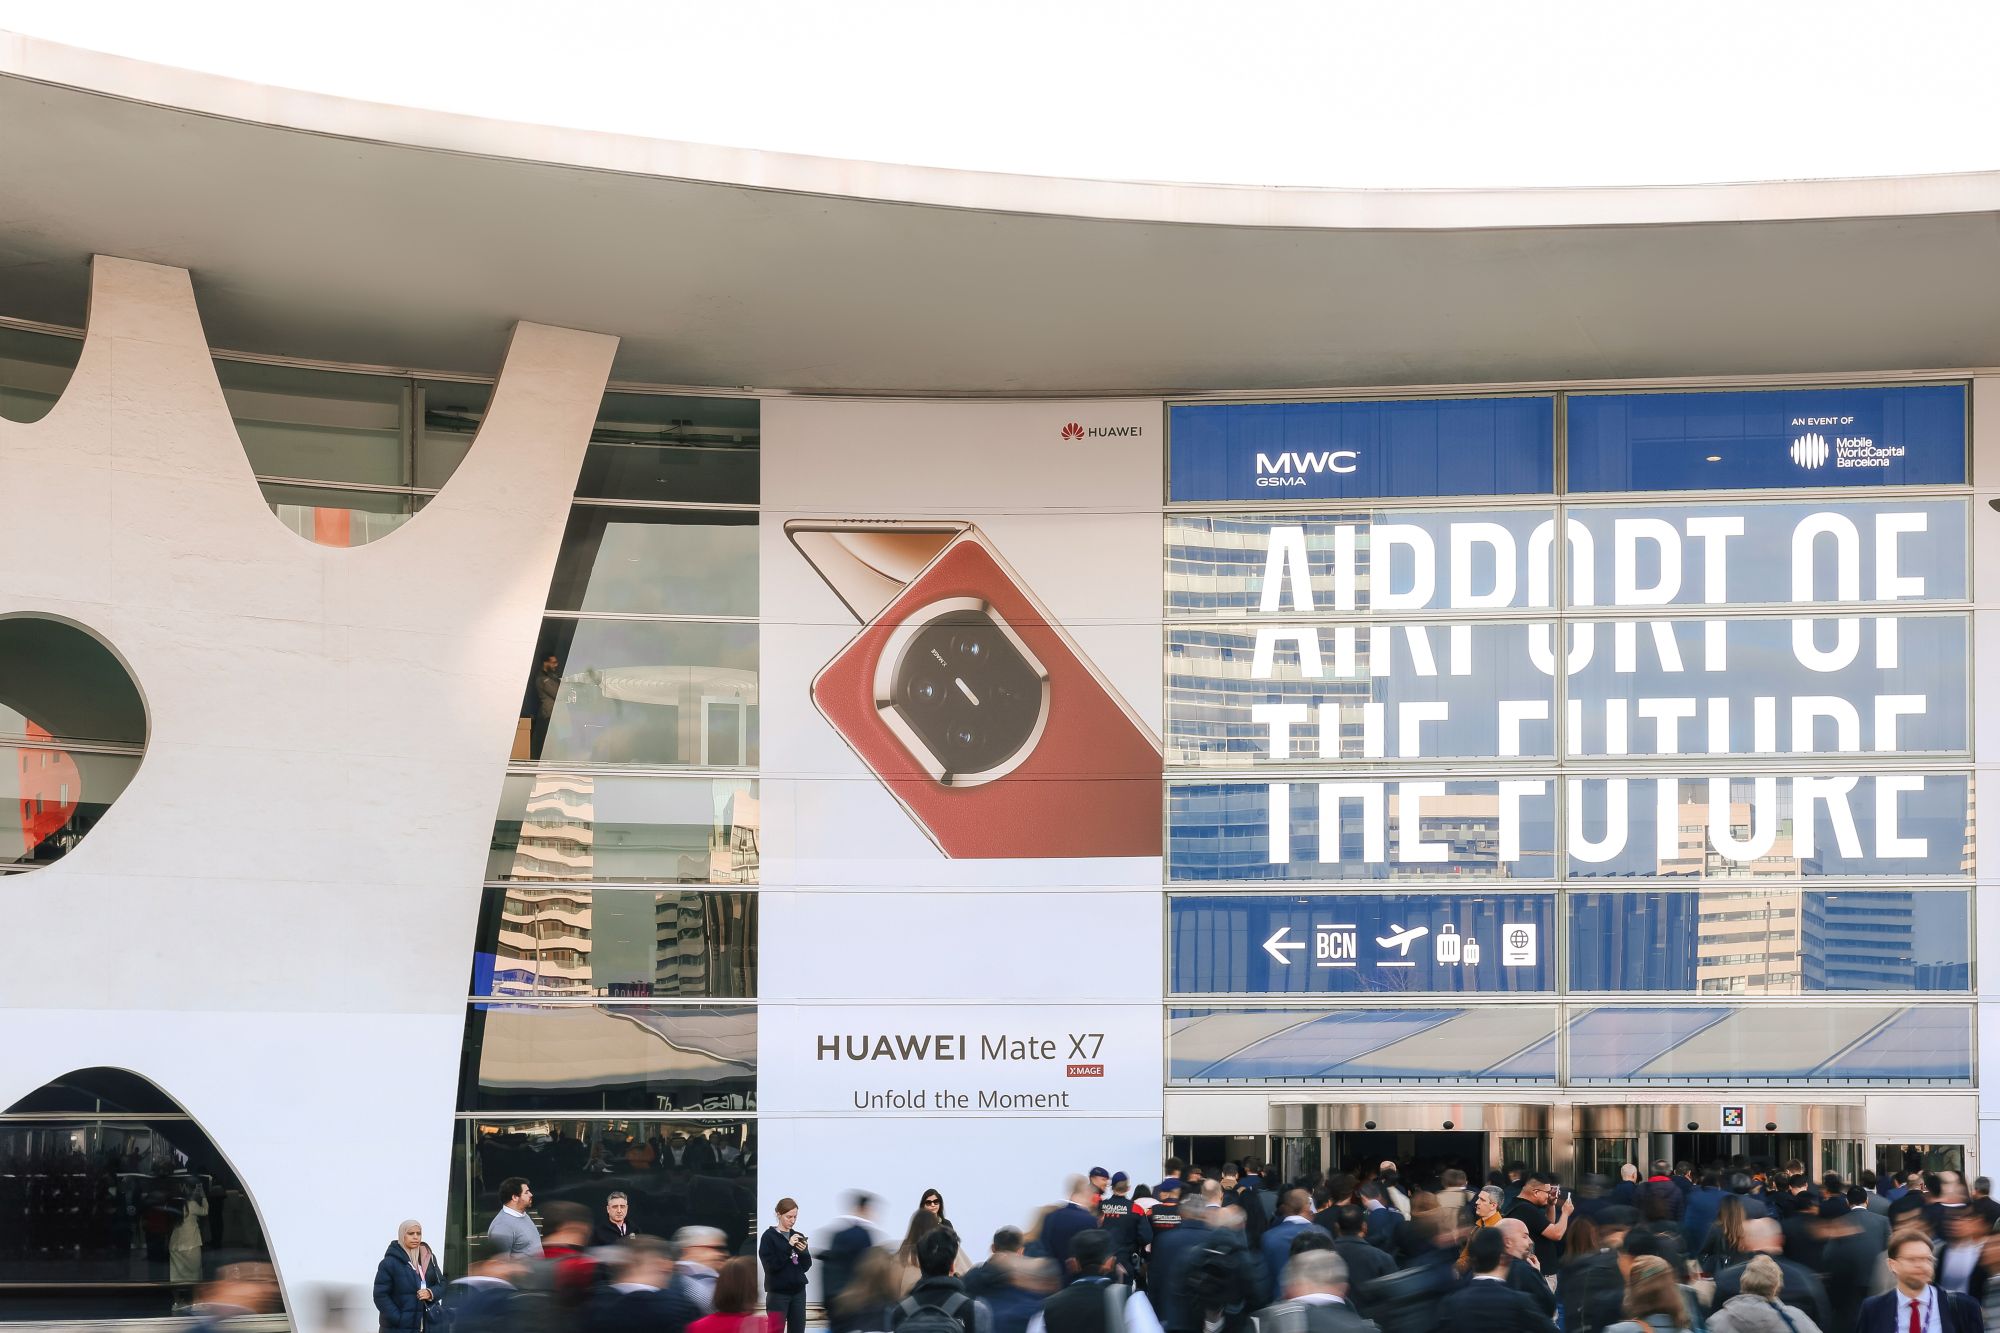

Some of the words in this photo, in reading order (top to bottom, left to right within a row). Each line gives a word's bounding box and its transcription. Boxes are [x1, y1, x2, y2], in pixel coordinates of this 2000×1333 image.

[1791, 418, 1805, 426] AN
[1808, 417, 1838, 425] EVENT
[1840, 416, 1854, 425] OF
[1088, 427, 1142, 437] HUAWEI
[1836, 436, 1873, 448] Mobile
[1836, 446, 1905, 459] WorldCapital
[1256, 451, 1357, 474] MWC
[1837, 457, 1890, 468] Barcelona
[1256, 477, 1307, 487] GSMA
[1250, 517, 1744, 678] AIRPORT
[1792, 512, 1927, 673] OF
[1251, 701, 1449, 864] THE
[1498, 694, 1928, 863] FUTURE
[1316, 932, 1357, 959] BCN
[817, 1035, 966, 1060] HUAWEI
[981, 1034, 1057, 1060] Mate
[1067, 1033, 1105, 1060] X7
[854, 1090, 925, 1109] Unfold
[934, 1090, 969, 1108] the
[978, 1090, 1069, 1109] Moment
